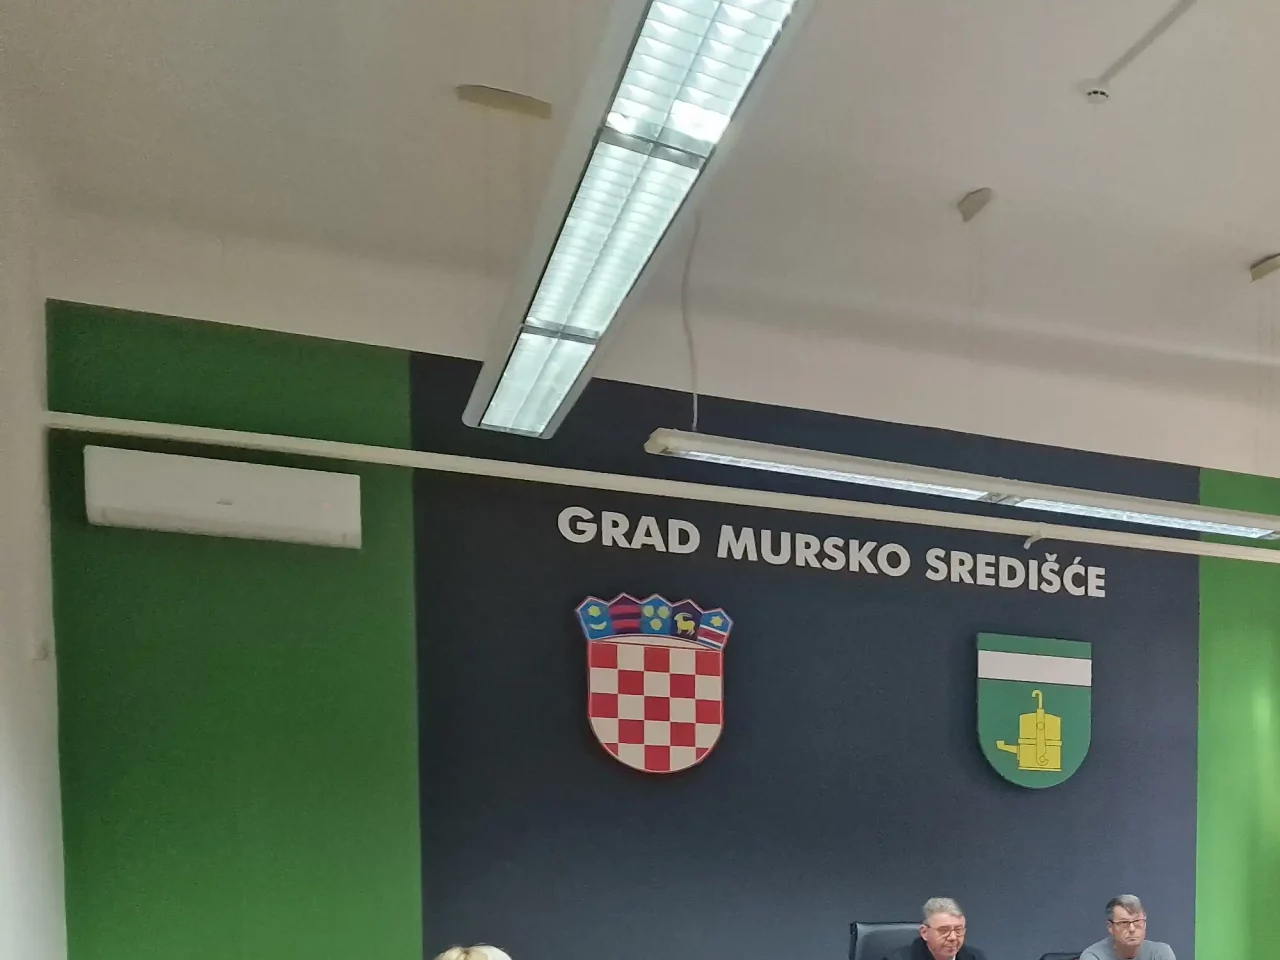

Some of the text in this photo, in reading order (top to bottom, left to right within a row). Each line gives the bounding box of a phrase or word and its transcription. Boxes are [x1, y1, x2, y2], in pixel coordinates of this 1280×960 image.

[557, 506, 1106, 597] GRAD MURSKO SREDIŠĆE
